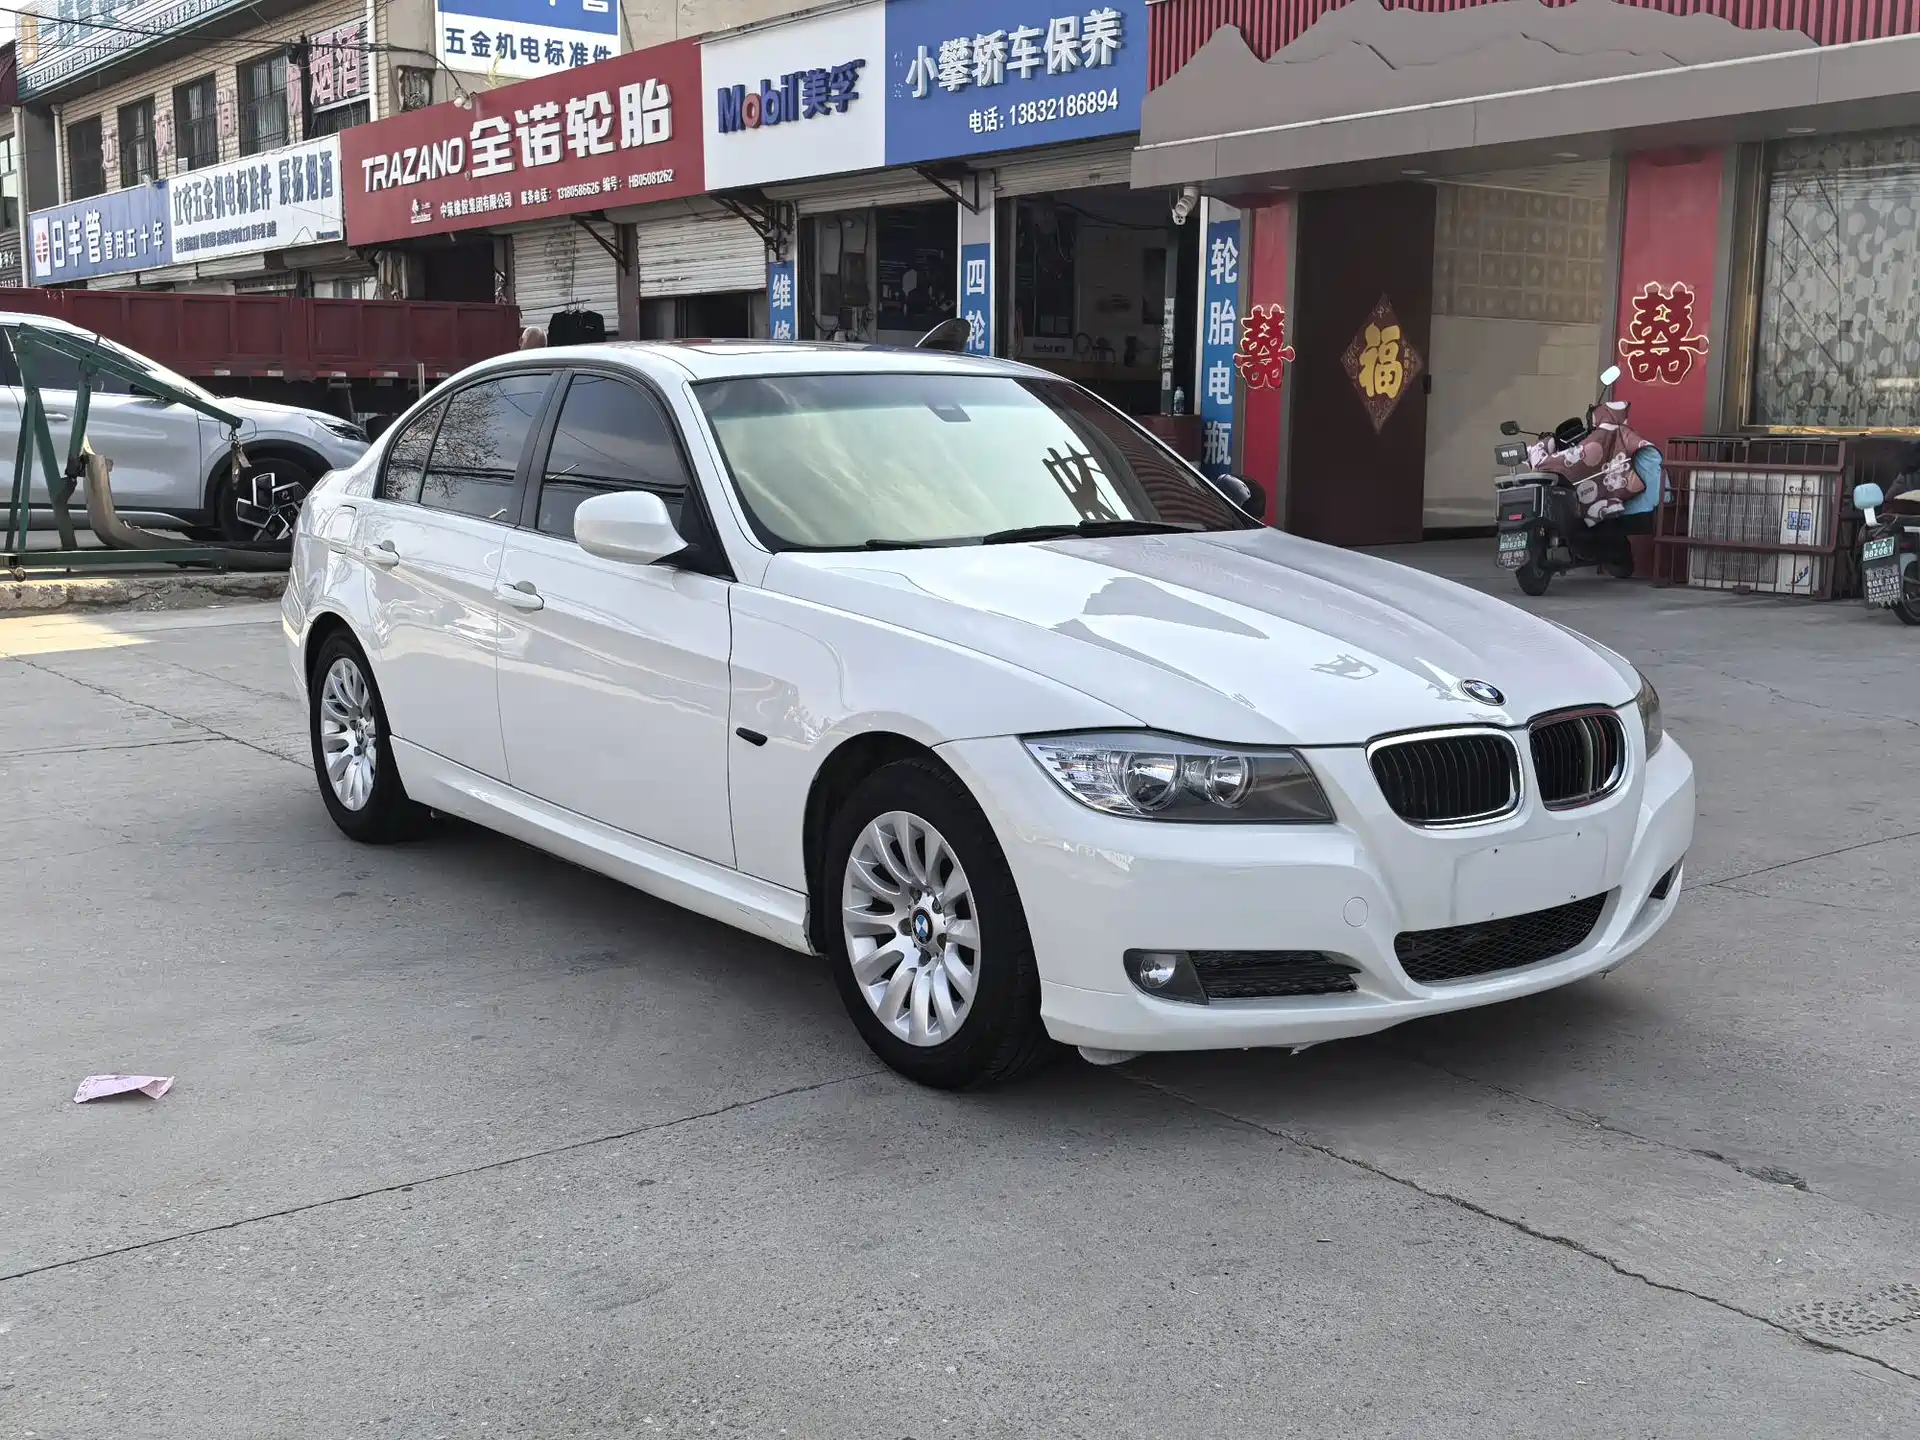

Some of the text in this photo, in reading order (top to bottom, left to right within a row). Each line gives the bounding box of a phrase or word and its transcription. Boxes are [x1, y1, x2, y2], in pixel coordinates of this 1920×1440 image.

[446, 27, 612, 68] 五金机电标准件
[905, 7, 1122, 99] 小攀轿车保养
[361, 78, 673, 193] TRAZANO 全诺轮胎
[718, 62, 861, 133] Mobil 美孚
[1009, 87, 1119, 126] 13832186894
[52, 209, 101, 268] 日丰管
[966, 259, 986, 351] 四轮
[1204, 237, 1239, 465] 轮胎电瓶
[1359, 322, 1404, 399] 福
